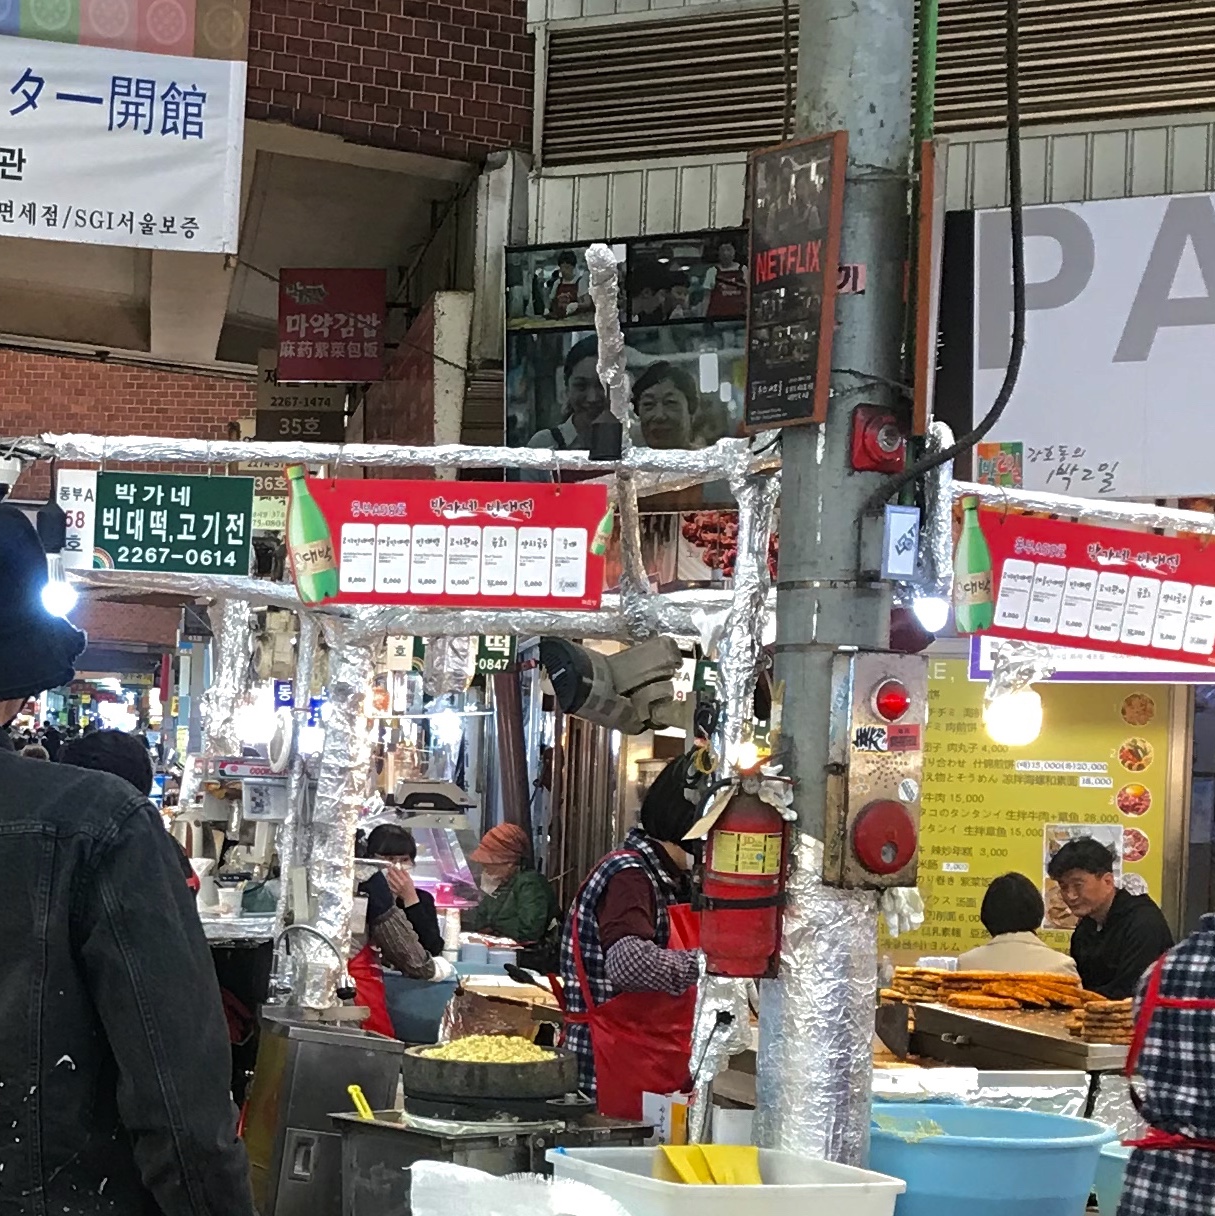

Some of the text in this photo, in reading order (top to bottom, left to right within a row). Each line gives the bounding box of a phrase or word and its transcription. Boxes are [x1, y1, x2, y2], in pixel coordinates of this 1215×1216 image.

[756, 239, 822, 284] NETFLIX
[286, 313, 382, 338] 마약김밥
[280, 417, 321, 435] 35호
[59, 486, 94, 502] 동부A
[115, 483, 191, 507] 박가네
[430, 496, 477, 517] 박가네
[486, 498, 534, 519] 빈대떡
[103, 507, 245, 546] 빈대떡,고기전
[65, 536, 83, 552] 호
[117, 547, 236, 567] 2267-0614
[923, 758, 966, 768] り合わせ
[922, 773, 998, 784] え物とそうめん
[921, 793, 984, 803] 牛肉 15,000
